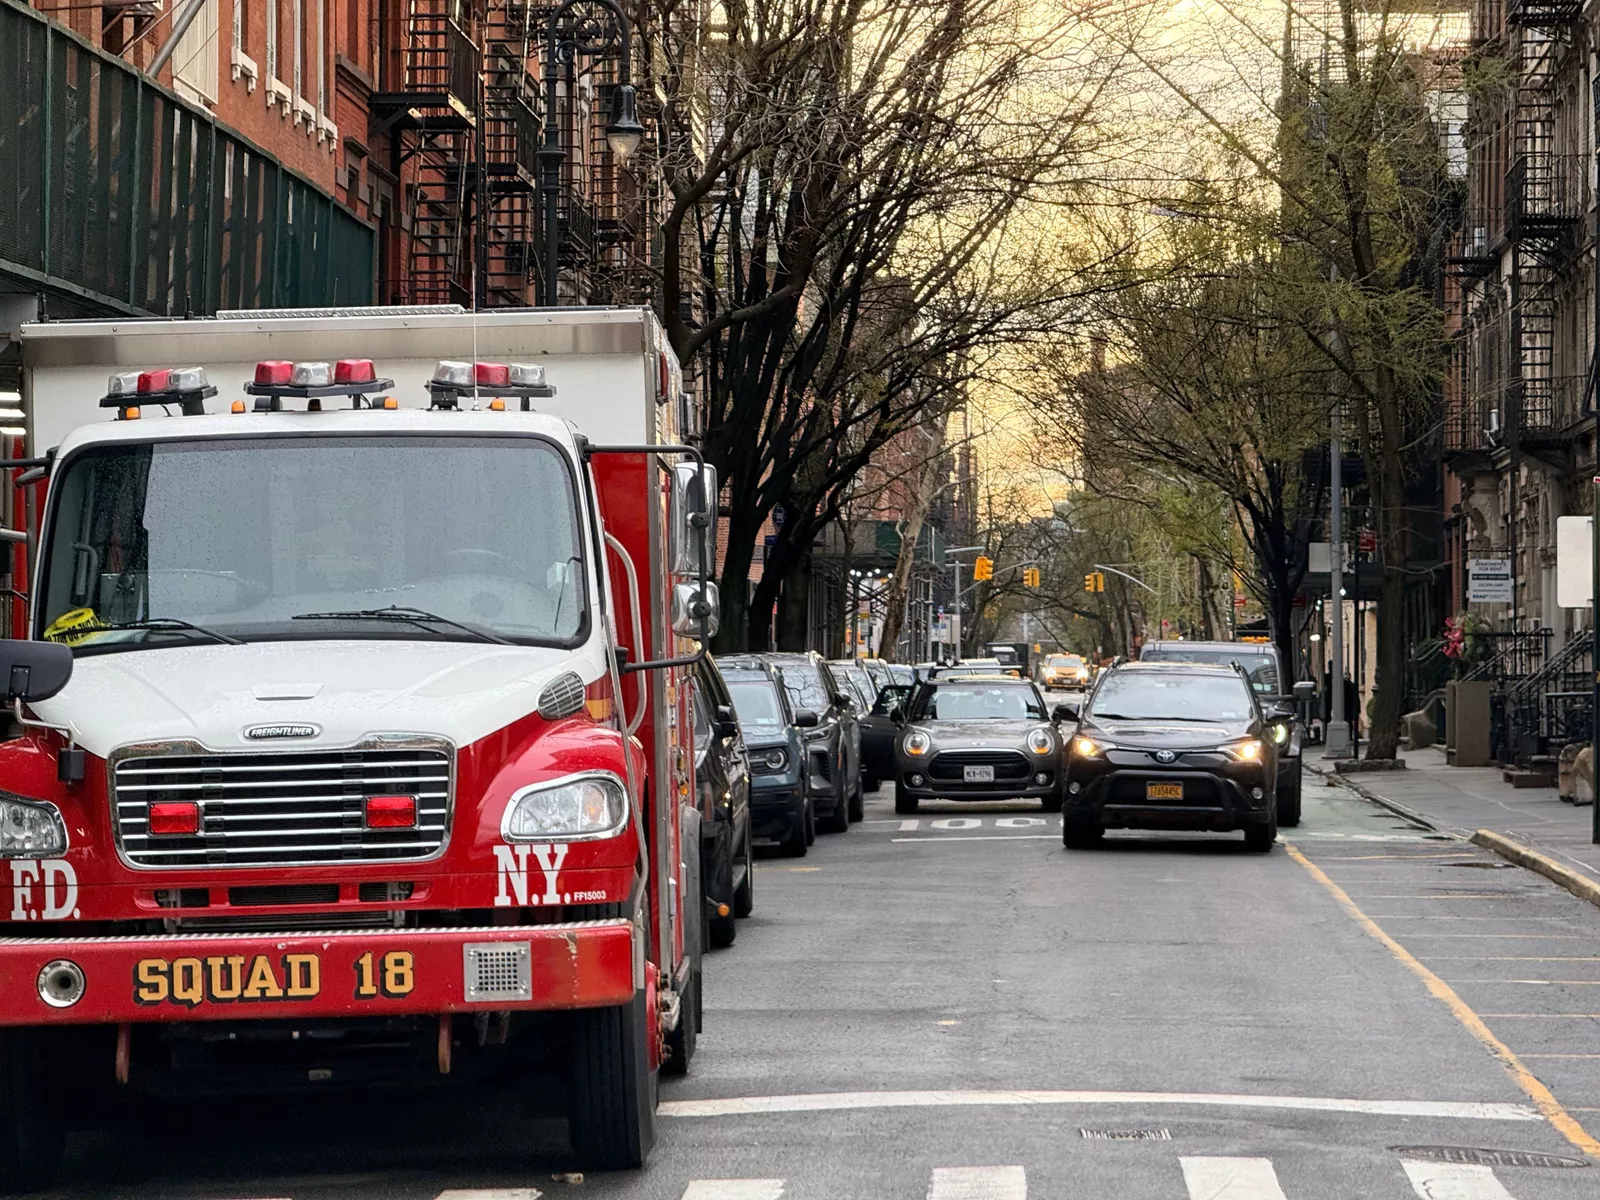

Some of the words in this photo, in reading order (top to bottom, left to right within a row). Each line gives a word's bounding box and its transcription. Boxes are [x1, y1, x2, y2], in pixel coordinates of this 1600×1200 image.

[250, 726, 313, 738] FREIGHTLINER
[9, 859, 81, 921] F.D.
[492, 843, 569, 906] N.Y.
[573, 890, 607, 902] FF15003
[134, 953, 321, 1008] SQUAD
[354, 951, 414, 999] 18
